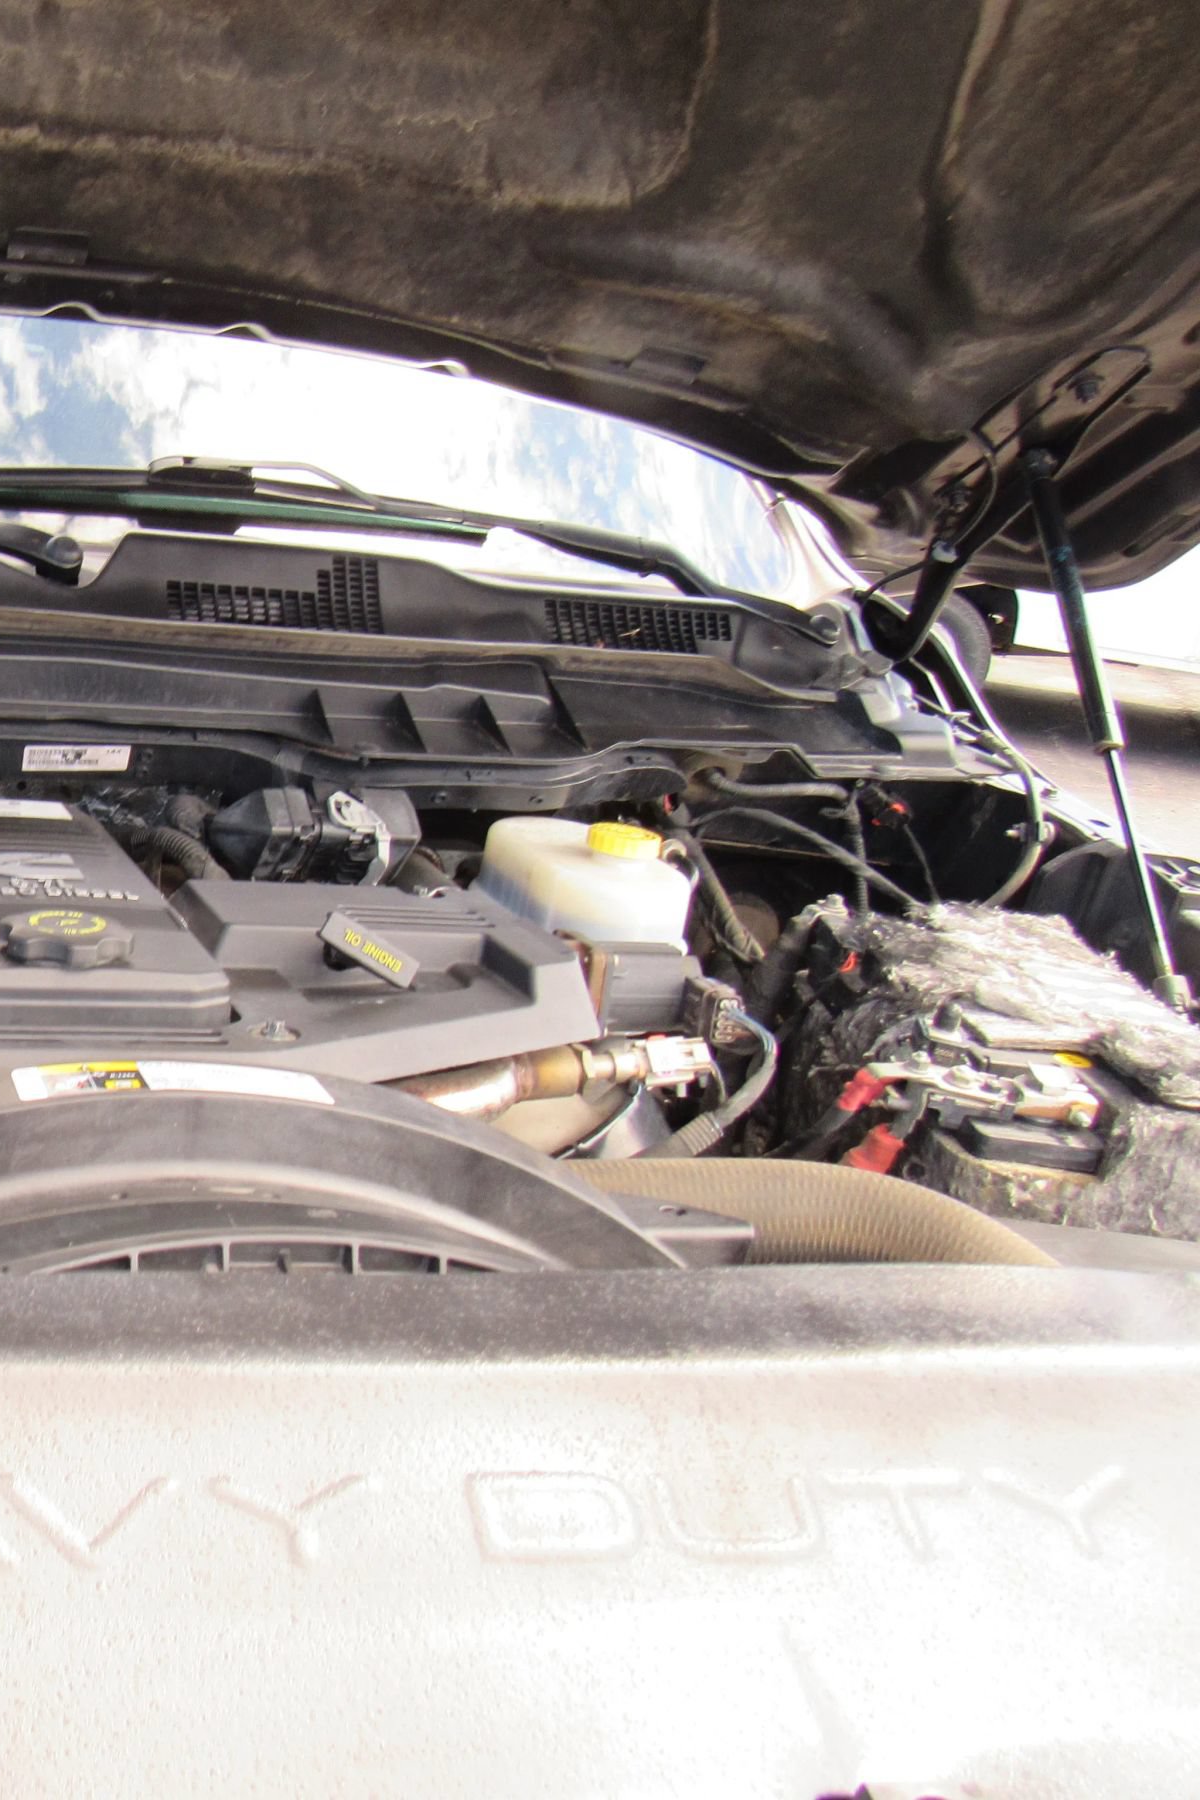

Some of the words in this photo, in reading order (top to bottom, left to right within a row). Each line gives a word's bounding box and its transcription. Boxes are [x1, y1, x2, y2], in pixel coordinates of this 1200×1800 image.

[344, 927, 362, 947] OIL
[362, 940, 403, 973] ENGINE
[464, 1464, 1128, 1566] DUTY
